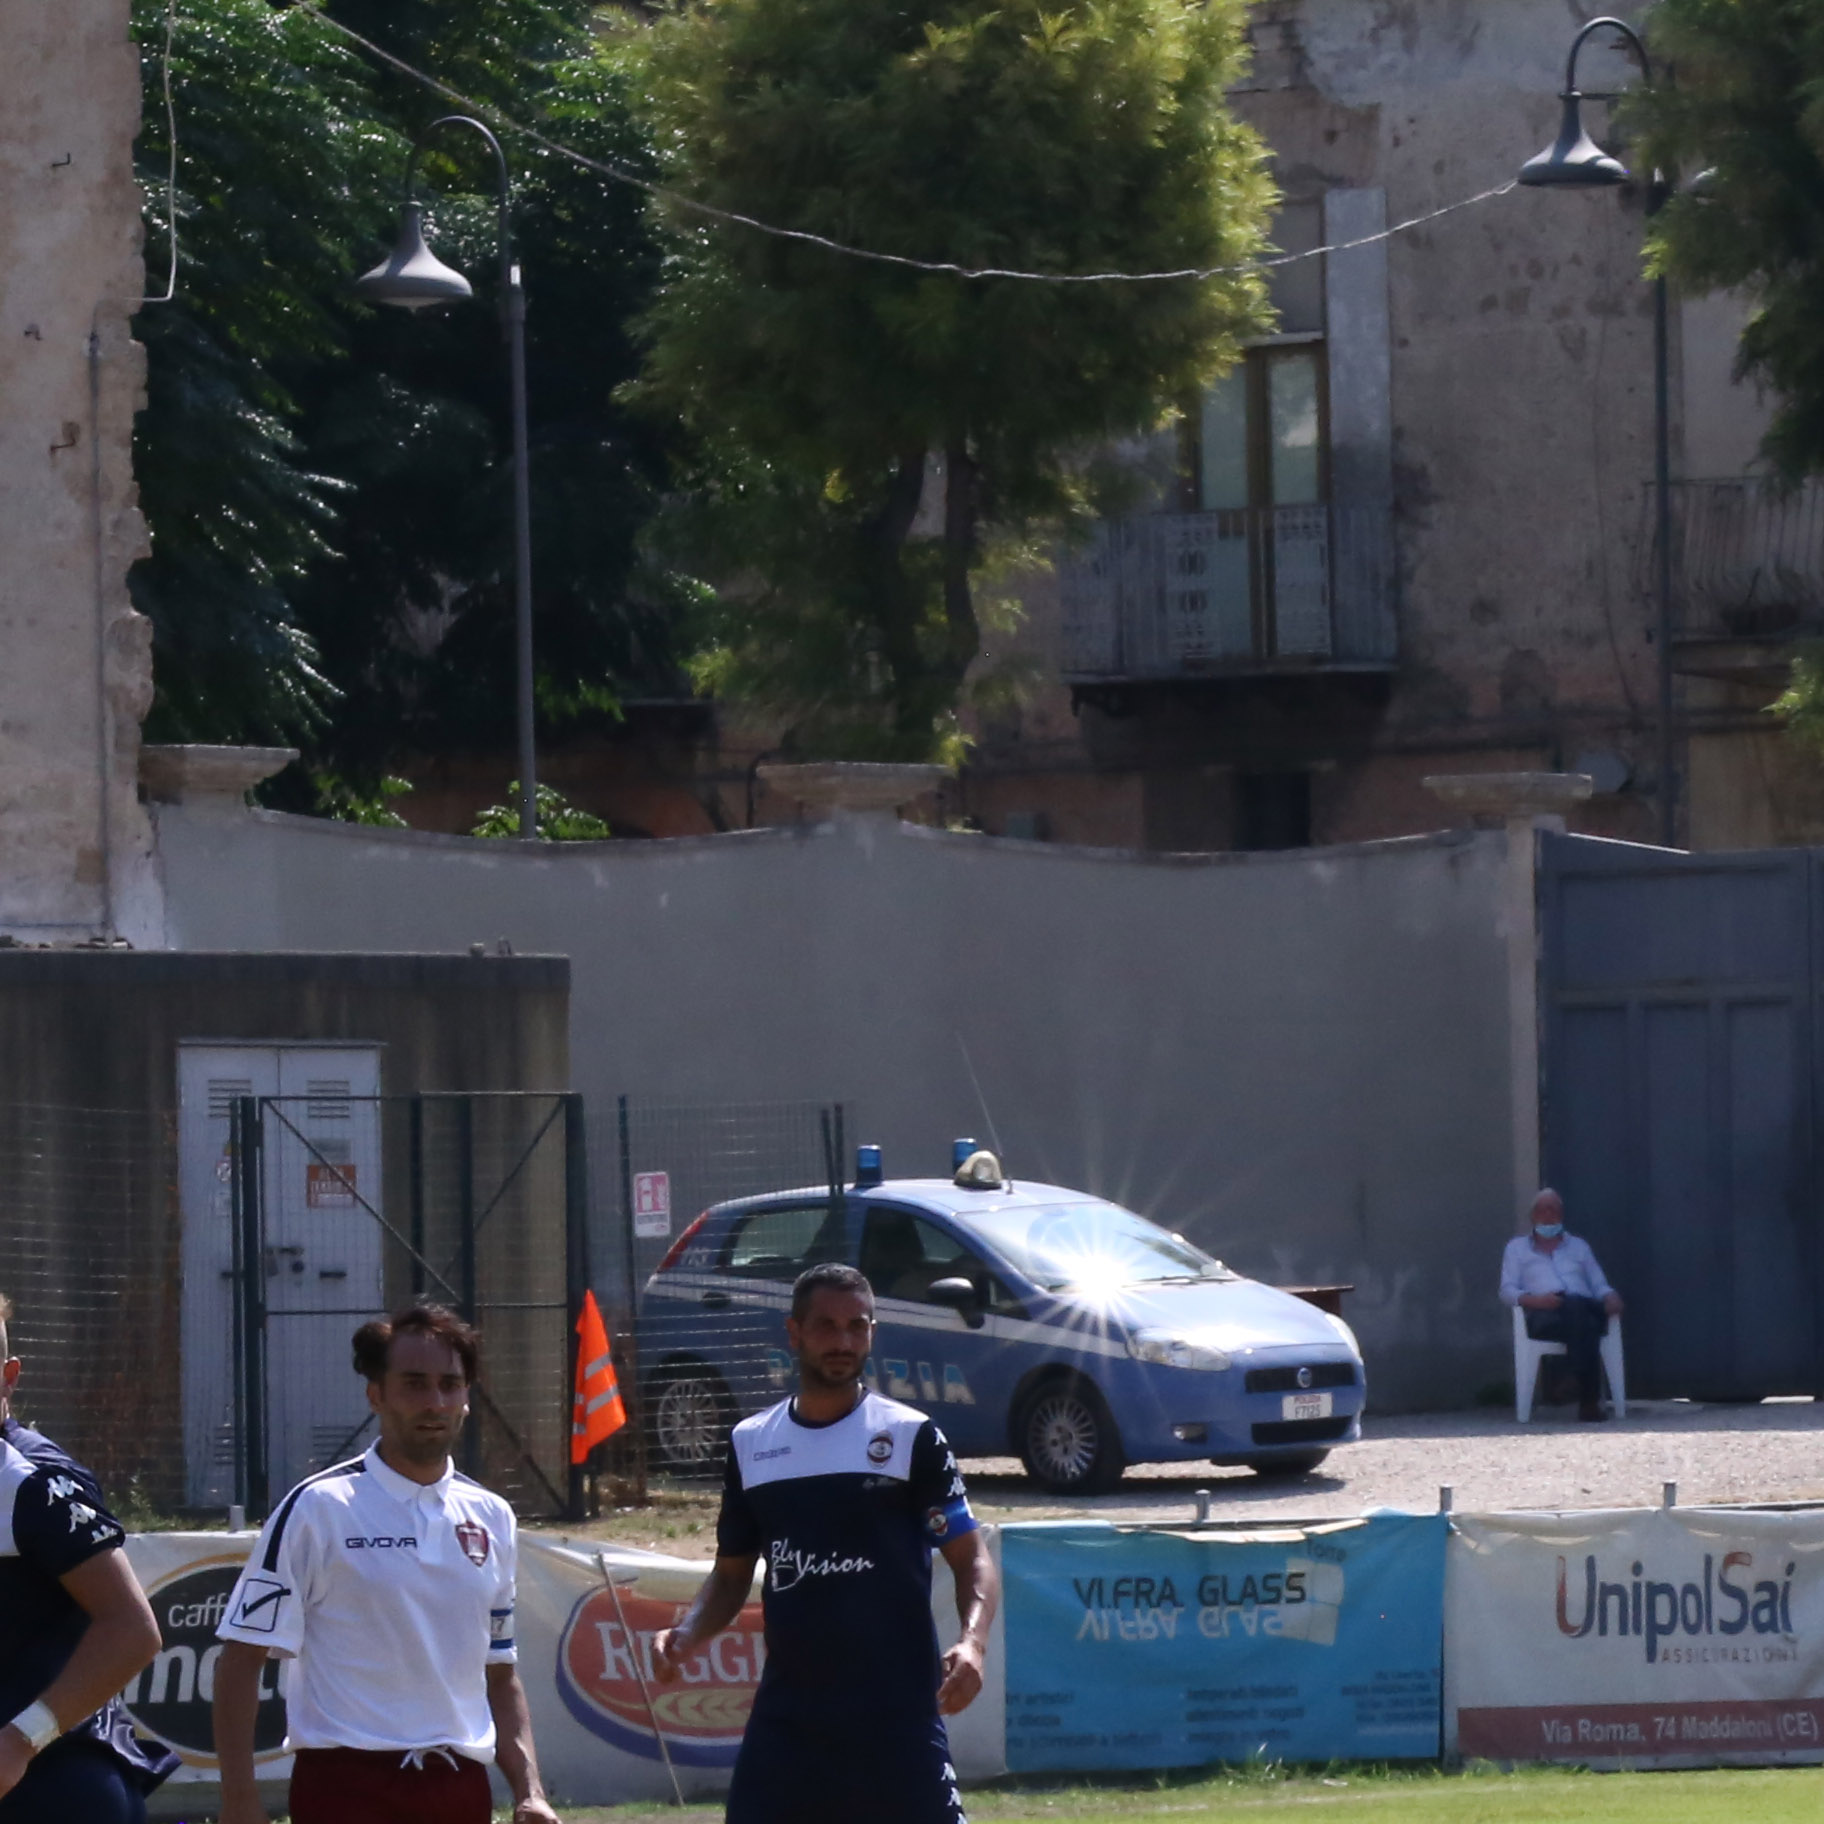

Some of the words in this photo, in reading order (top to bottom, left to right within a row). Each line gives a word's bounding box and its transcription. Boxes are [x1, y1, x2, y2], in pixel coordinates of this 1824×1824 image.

[767, 1348, 976, 1405] PIZIA
[345, 1537, 418, 1549] GIVOVA
[1197, 1572, 1307, 1608] GLASS
[168, 1593, 228, 1628] caff
[1556, 1552, 1797, 1664] UnipolSai
[1541, 1719, 1572, 1745] Via
[1653, 1716, 1677, 1741] 74
[1681, 1713, 1773, 1741] Maddaloni
[1776, 1711, 1820, 1743] (CE)
